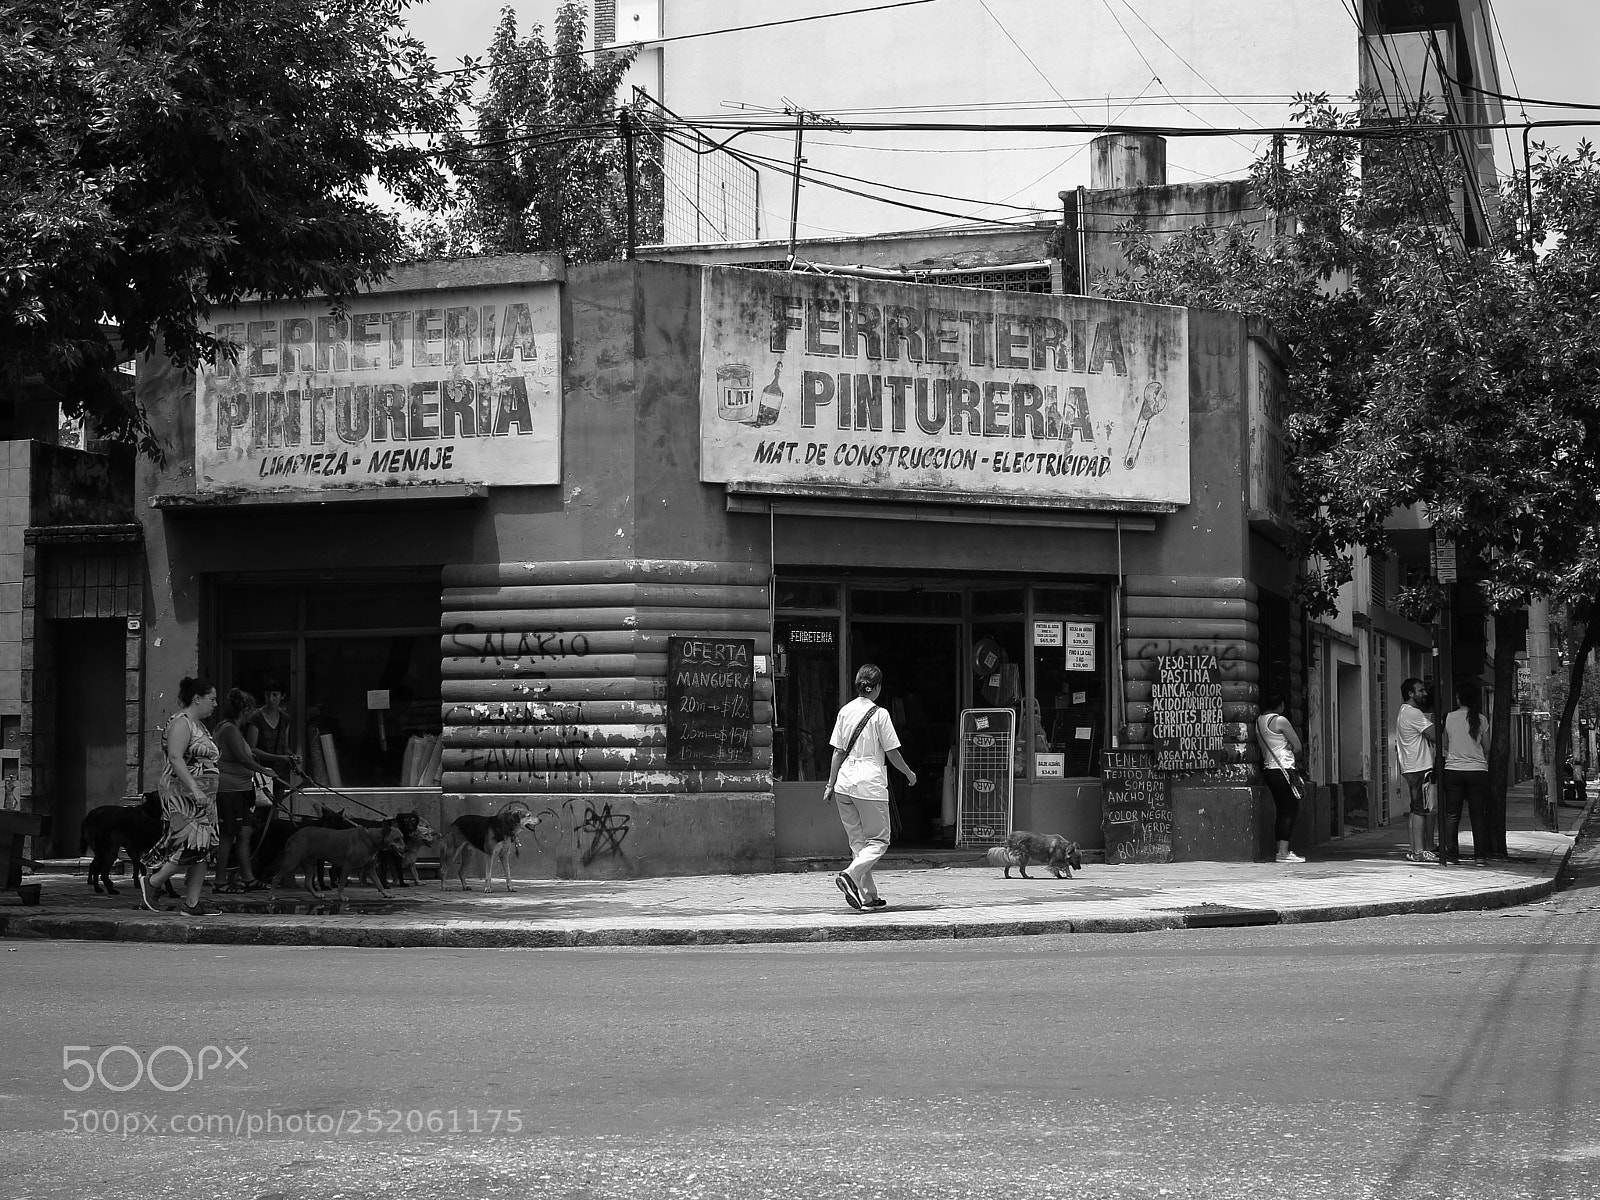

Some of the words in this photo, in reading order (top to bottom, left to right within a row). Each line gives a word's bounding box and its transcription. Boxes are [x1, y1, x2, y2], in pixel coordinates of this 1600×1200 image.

[214, 302, 538, 380] FERRETERIA
[770, 295, 1128, 377] FERRETERIA
[216, 376, 534, 450] PINTURERIA
[801, 370, 1096, 443] PINTURERIA
[259, 451, 347, 478] LIMPIEZA
[367, 446, 454, 474] MENAJE
[803, 442, 828, 466] DE
[834, 443, 977, 473] CONSTRUCCION
[993, 451, 1111, 479] ELECTRICIDAD
[790, 630, 833, 643] FERRETERIA
[683, 641, 747, 661] OFERTA
[676, 671, 751, 688] MANGUERA
[1160, 669, 1210, 683] PASTINA
[1152, 683, 1186, 698] BLANCA
[1194, 683, 1222, 697] COLOR
[1152, 697, 1181, 711] ACIDO
[1181, 696, 1223, 711] MURIATICO
[1153, 710, 1197, 724] FERRITES
[1201, 709, 1223, 723] BREA
[1152, 723, 1193, 738] CEMENTO
[1194, 722, 1224, 737] BLANCO
[1158, 750, 1209, 761] ARGAMASA
[1158, 759, 1184, 770] ACEITE
[1104, 769, 1143, 780] TEJIDO
[1124, 780, 1164, 792] SOMBRA
[1108, 791, 1145, 802] ANCHO
[1108, 810, 1139, 822] COLOR
[1141, 810, 1173, 821] NEGRO
[1141, 822, 1172, 834] VERDE
